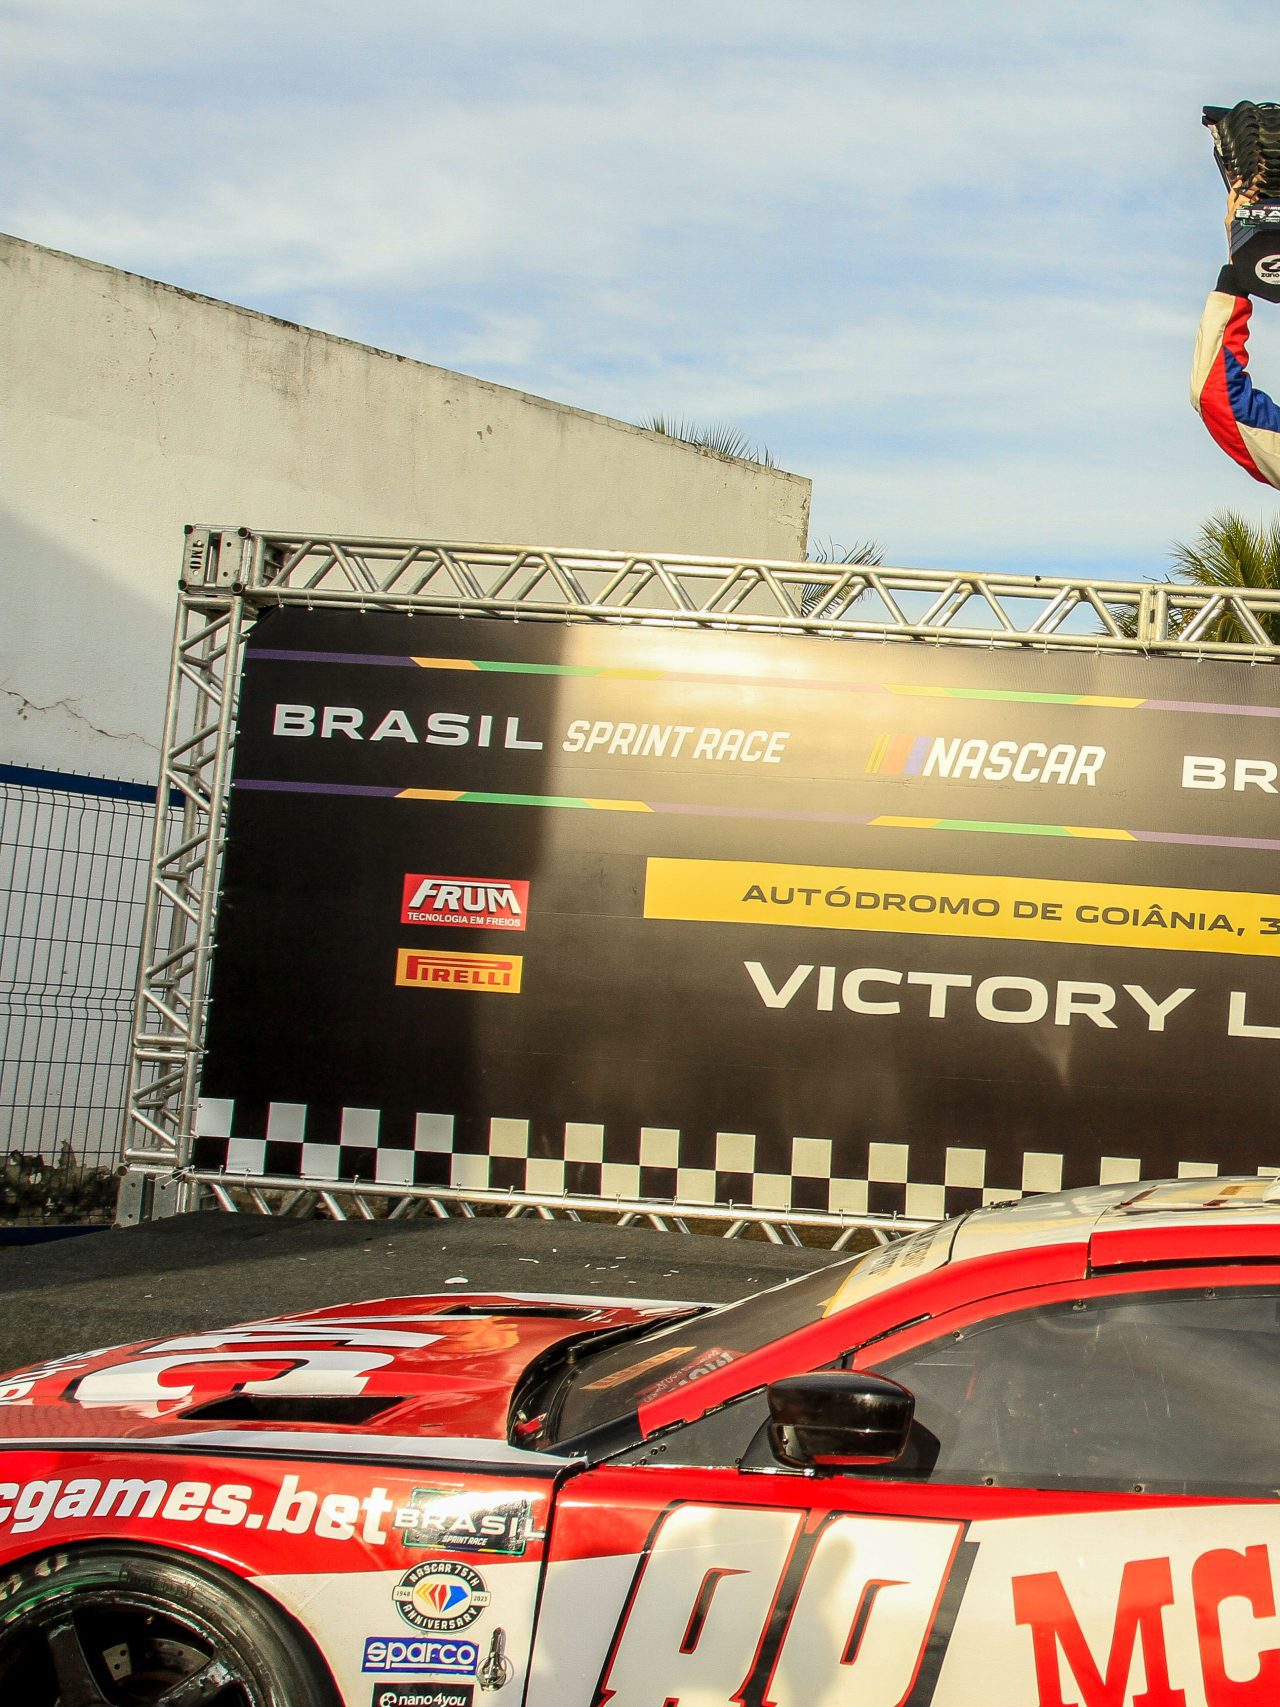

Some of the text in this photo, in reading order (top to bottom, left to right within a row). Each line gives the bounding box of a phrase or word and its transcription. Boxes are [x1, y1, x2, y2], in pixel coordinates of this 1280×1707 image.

[273, 704, 791, 763] BRASIL SPRINT RACE
[922, 737, 1107, 787] NASCAR
[408, 880, 522, 914] FRUM
[742, 884, 1000, 917] AUTÓDROMO
[1012, 900, 1064, 922] DE
[1076, 905, 1245, 937] GOIÂNIA,
[408, 912, 521, 927] TECNOLOGIA EM FREIOS
[406, 956, 513, 986] PIRELLI
[743, 961, 1196, 1031] VICTORY
[394, 1507, 547, 1540] BRASIL
[442, 1535, 489, 1546] SPRINT RACE
[409, 1563, 480, 1587] NASCAR 75TH
[403, 1603, 479, 1630] ANNIVERSARY
[366, 1641, 476, 1670] sparco
[399, 1692, 467, 1707] nano4you
